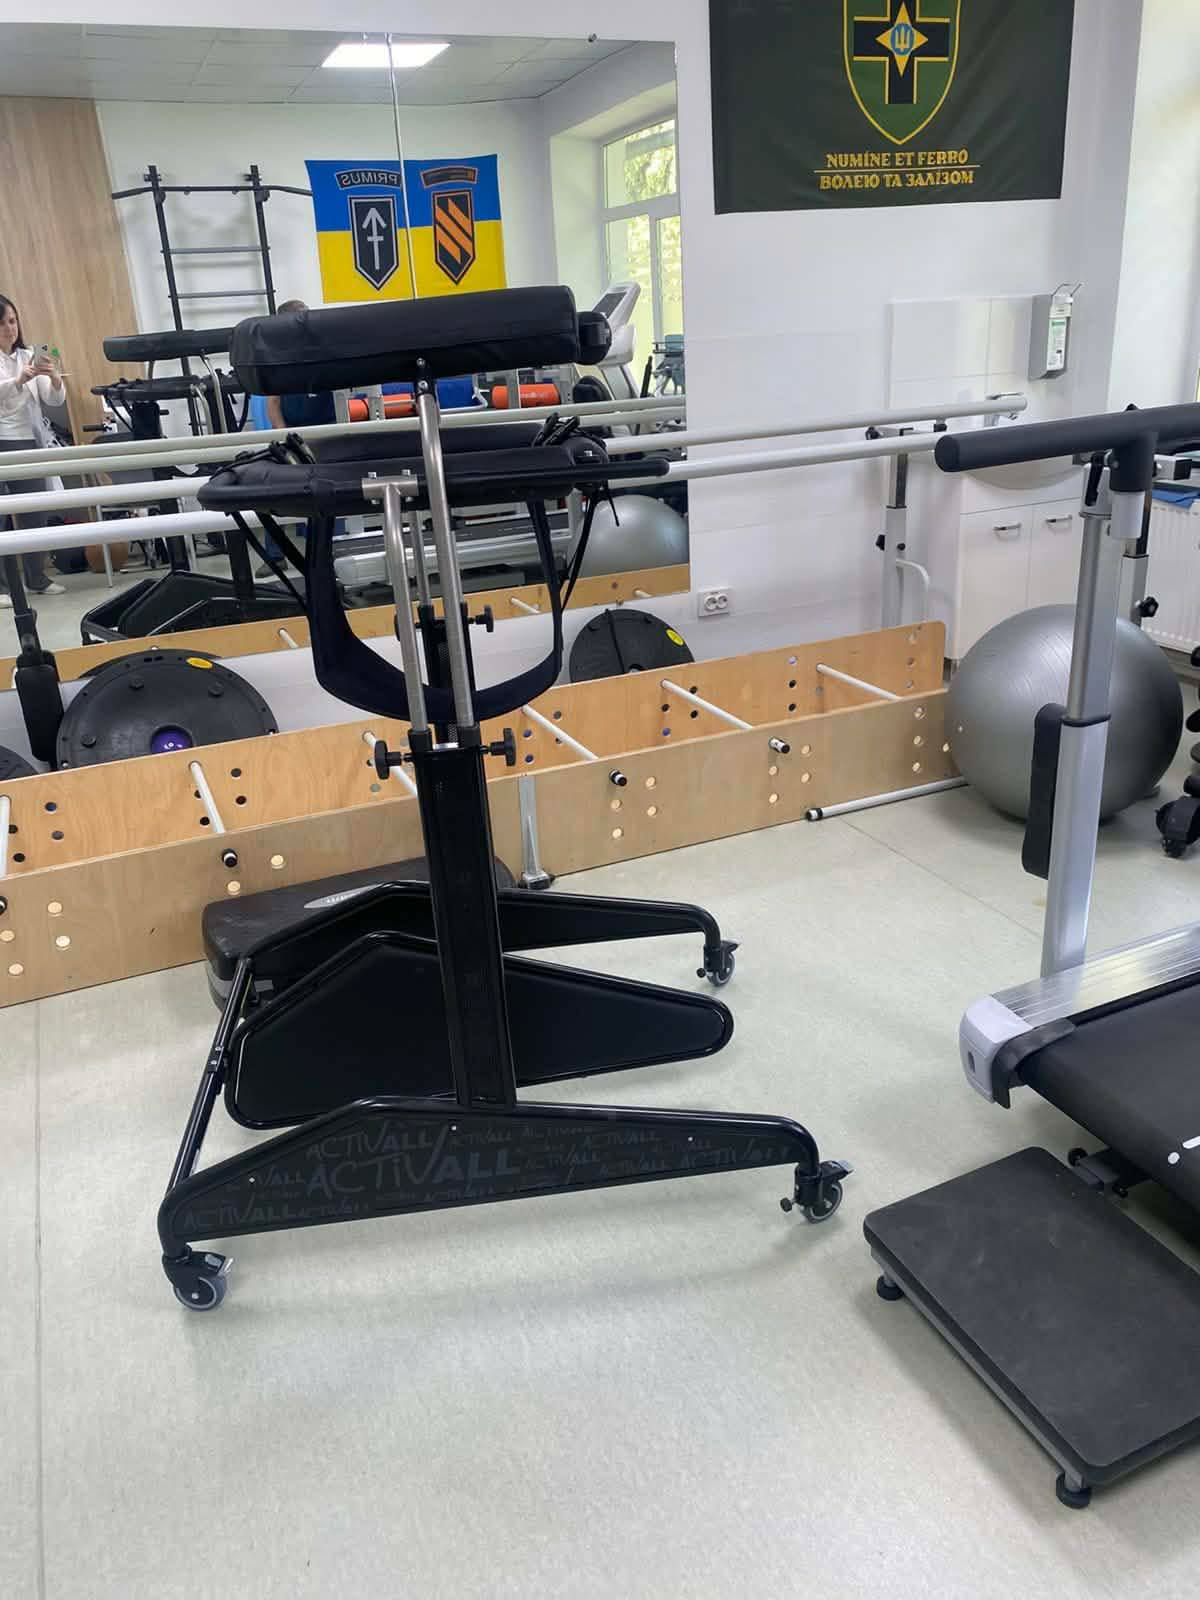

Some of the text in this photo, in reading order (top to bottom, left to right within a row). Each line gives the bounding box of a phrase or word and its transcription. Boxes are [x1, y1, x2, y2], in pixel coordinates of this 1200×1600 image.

[895, 152, 914, 167] ET
[918, 149, 969, 166] FERRO
[819, 170, 974, 190] ВОЛЕЮ ТА ЗАЛІЗОМ
